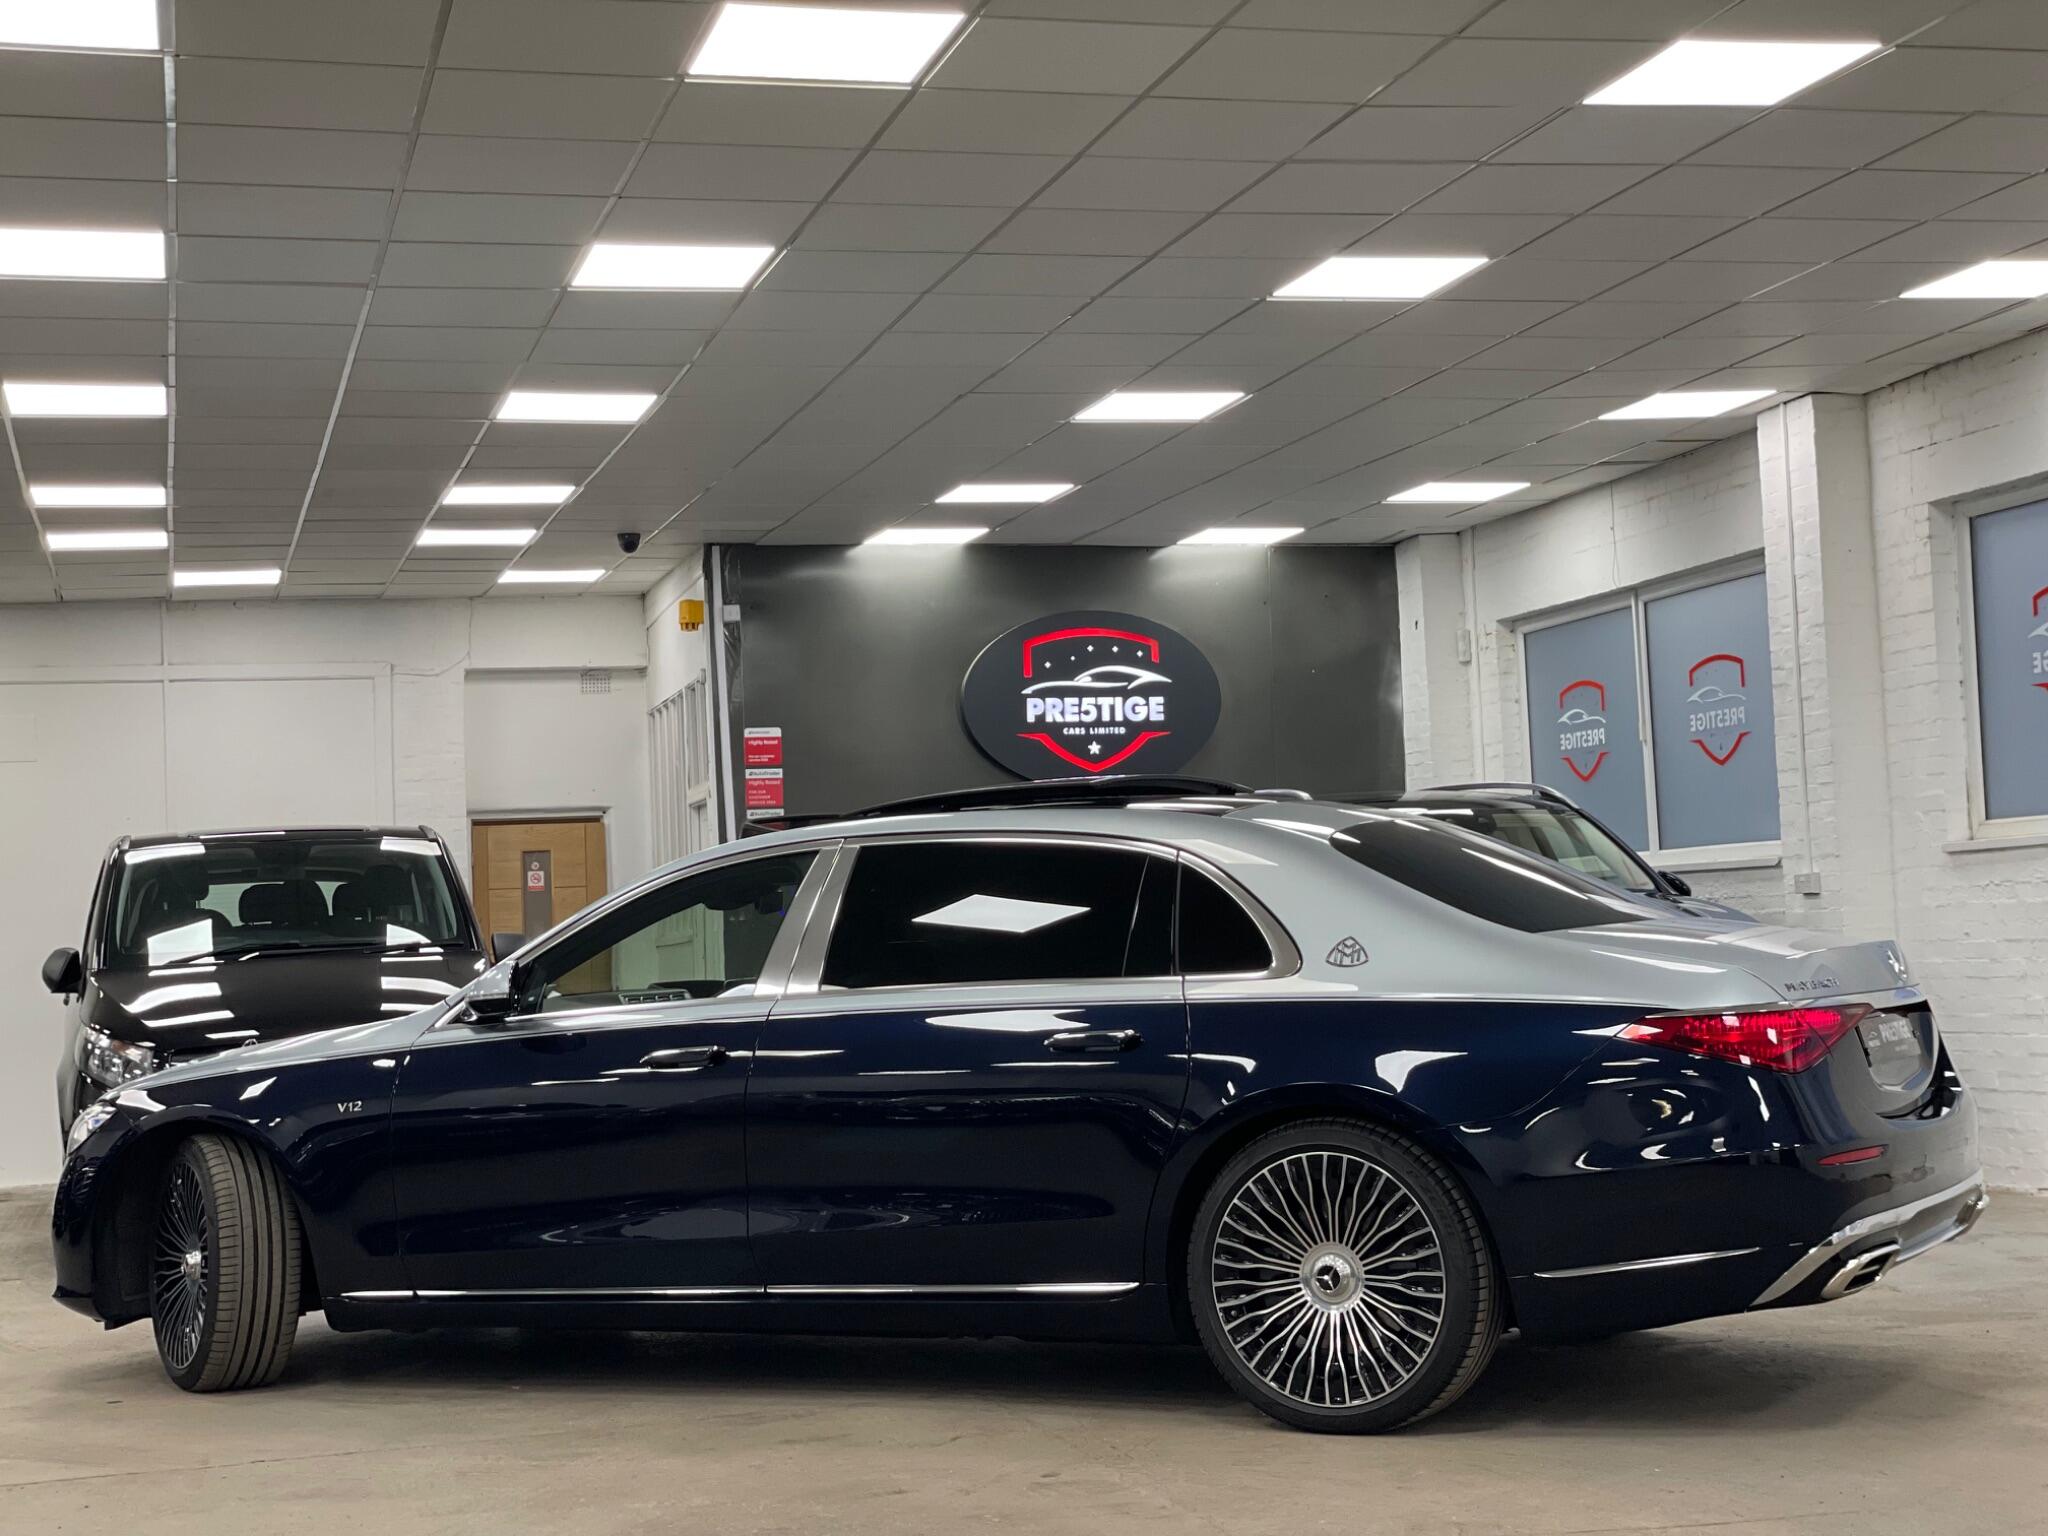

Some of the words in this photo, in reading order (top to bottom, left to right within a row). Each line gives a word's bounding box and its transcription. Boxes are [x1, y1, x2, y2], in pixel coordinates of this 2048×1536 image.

[1063, 727, 1086, 735] CARS
[1089, 726, 1126, 735] LIMITED
[337, 1101, 363, 1113] V12
